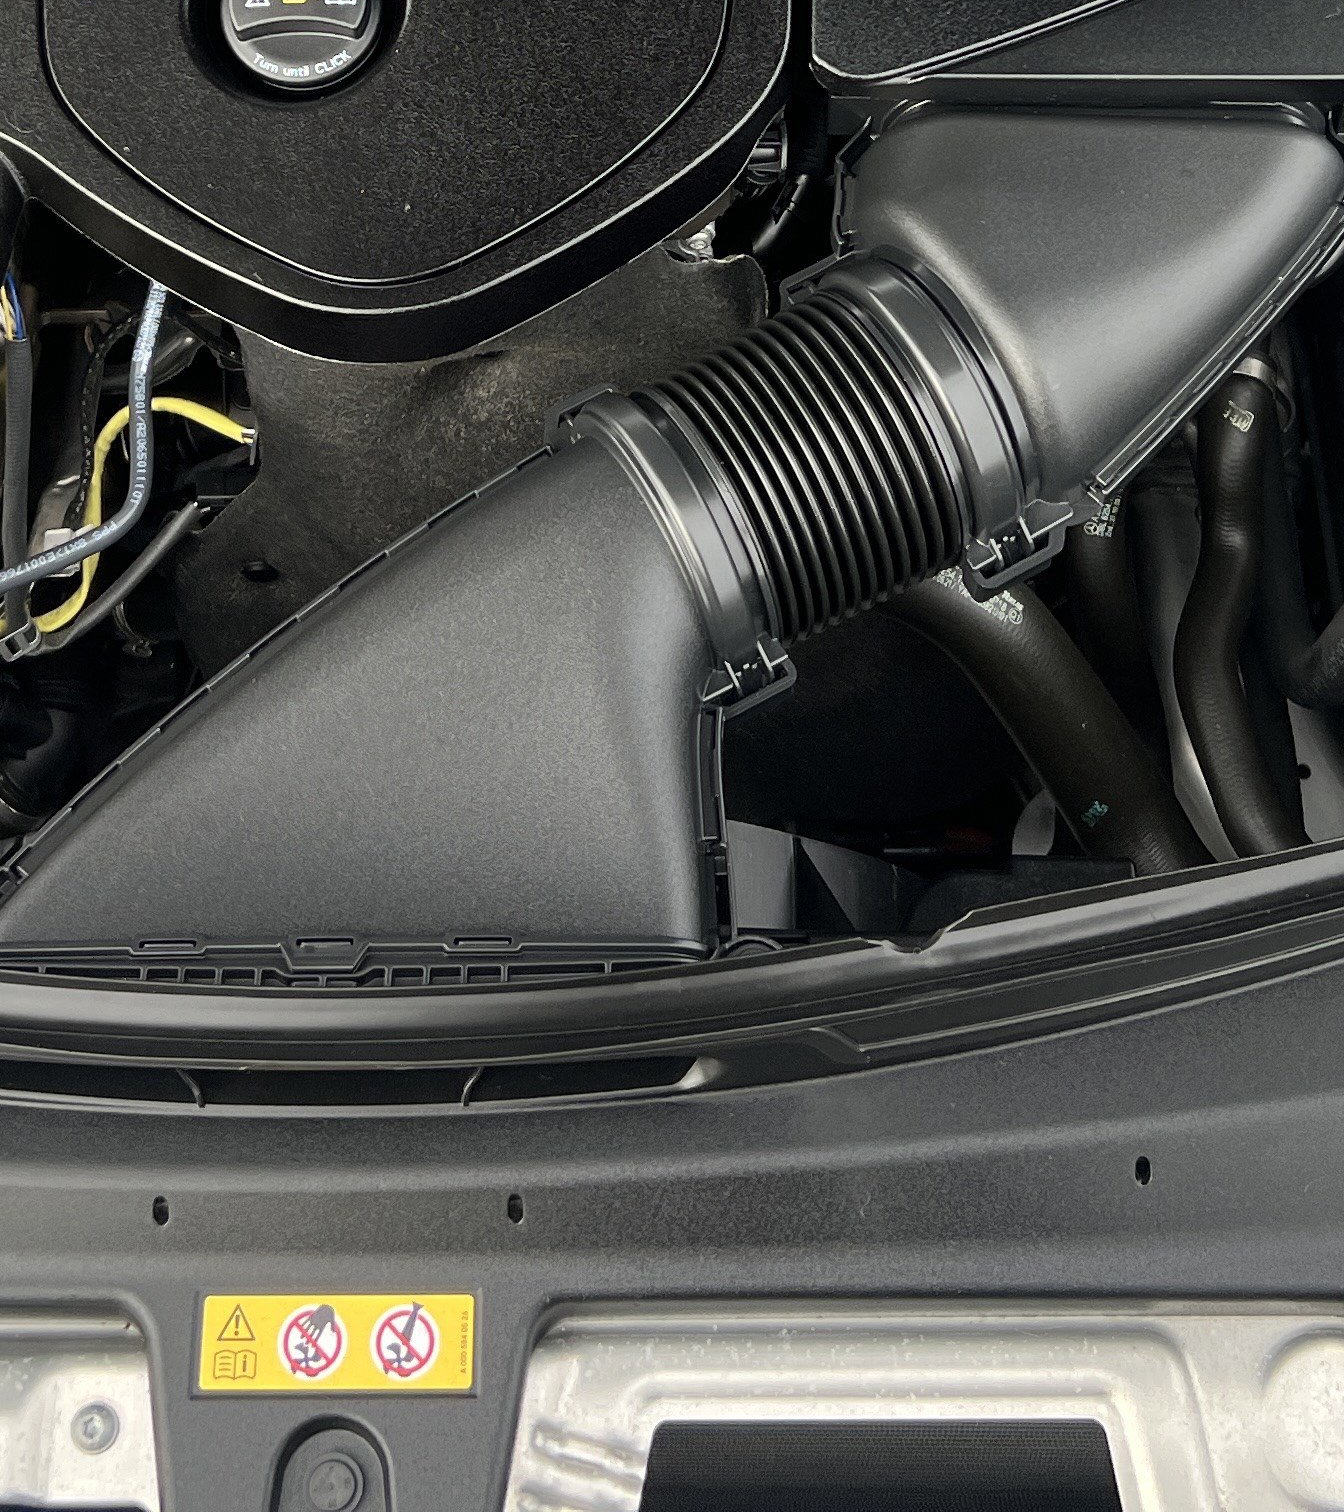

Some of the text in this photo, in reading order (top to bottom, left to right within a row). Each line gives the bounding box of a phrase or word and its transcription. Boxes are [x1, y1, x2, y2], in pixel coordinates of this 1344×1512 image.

[253, 49, 352, 77] Turn until CLICK
